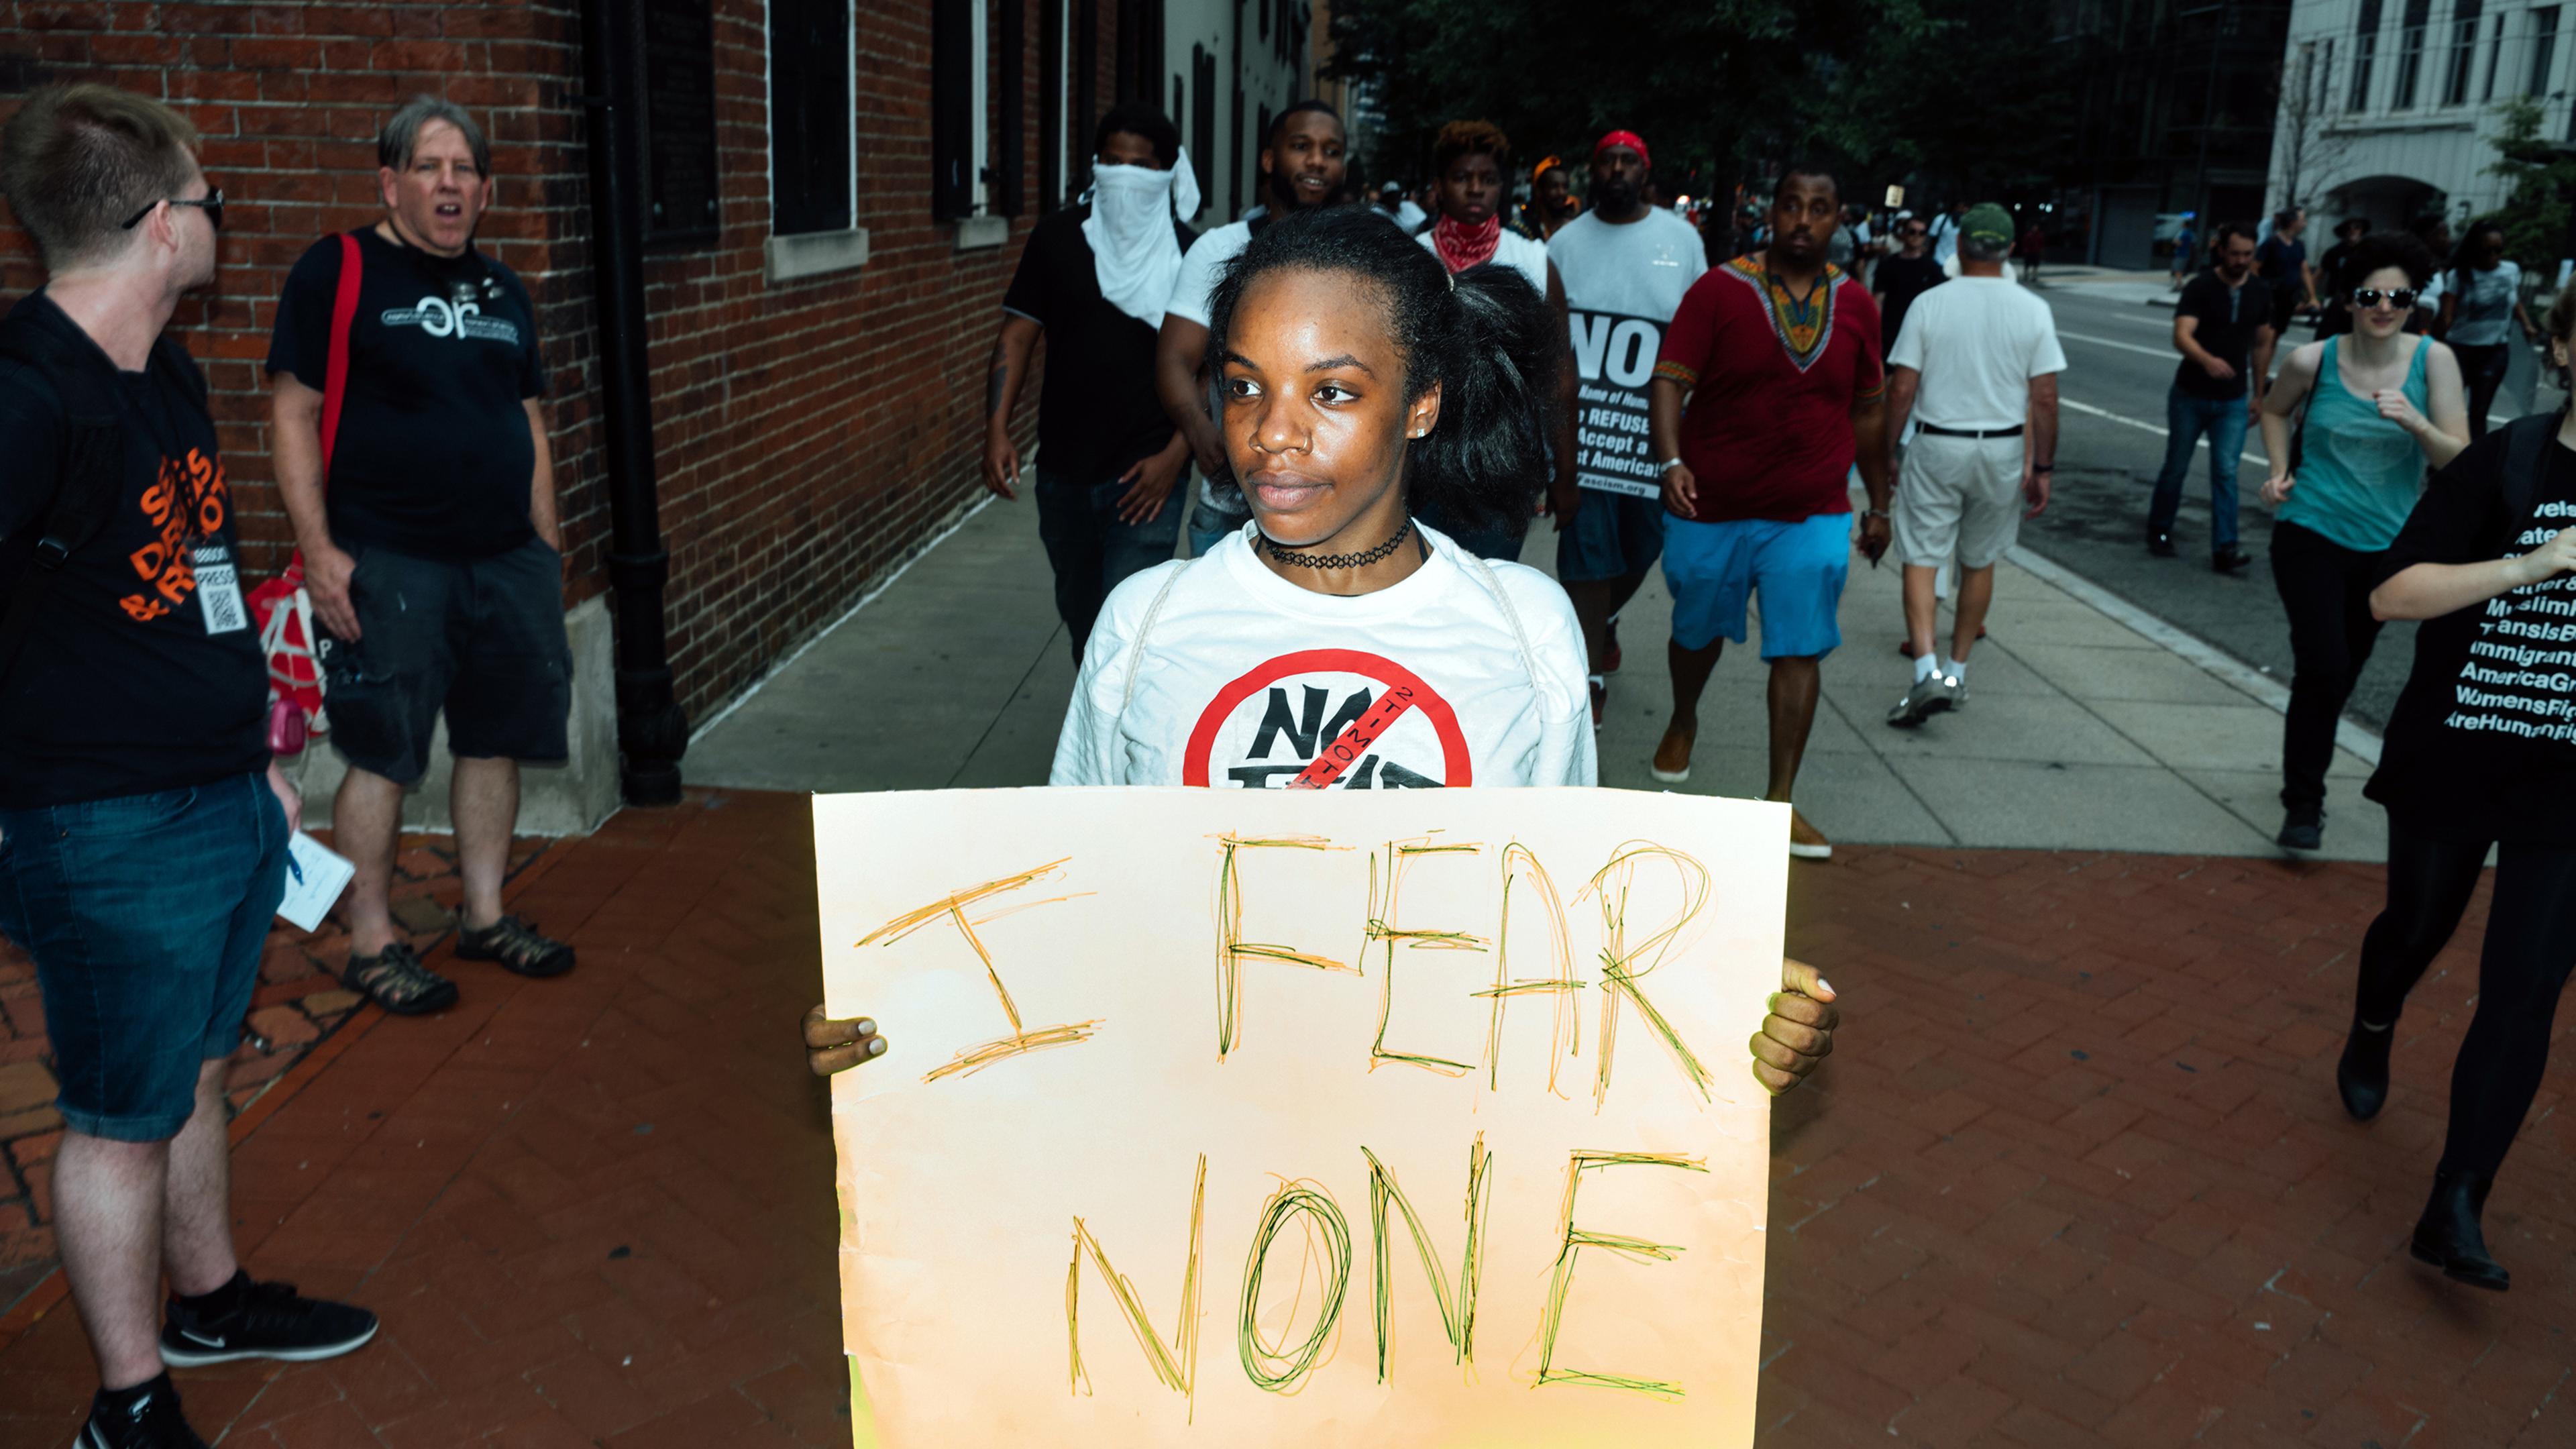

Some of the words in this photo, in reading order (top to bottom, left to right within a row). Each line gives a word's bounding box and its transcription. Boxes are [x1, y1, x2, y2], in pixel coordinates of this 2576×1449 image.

[1568, 312, 1661, 388] NO
[1609, 390, 1623, 405] of
[1621, 392, 1650, 411] Hum
[1588, 407, 1650, 435] REFUSE
[1578, 427, 1633, 454] Accept
[1636, 441, 1649, 455] a
[1590, 450, 1660, 478] America!
[1395, 686, 1414, 702] 2
[853, 856, 1107, 1085] I
[1204, 828, 1735, 1116] FEAR
[1064, 1130, 1711, 1427] NONE
